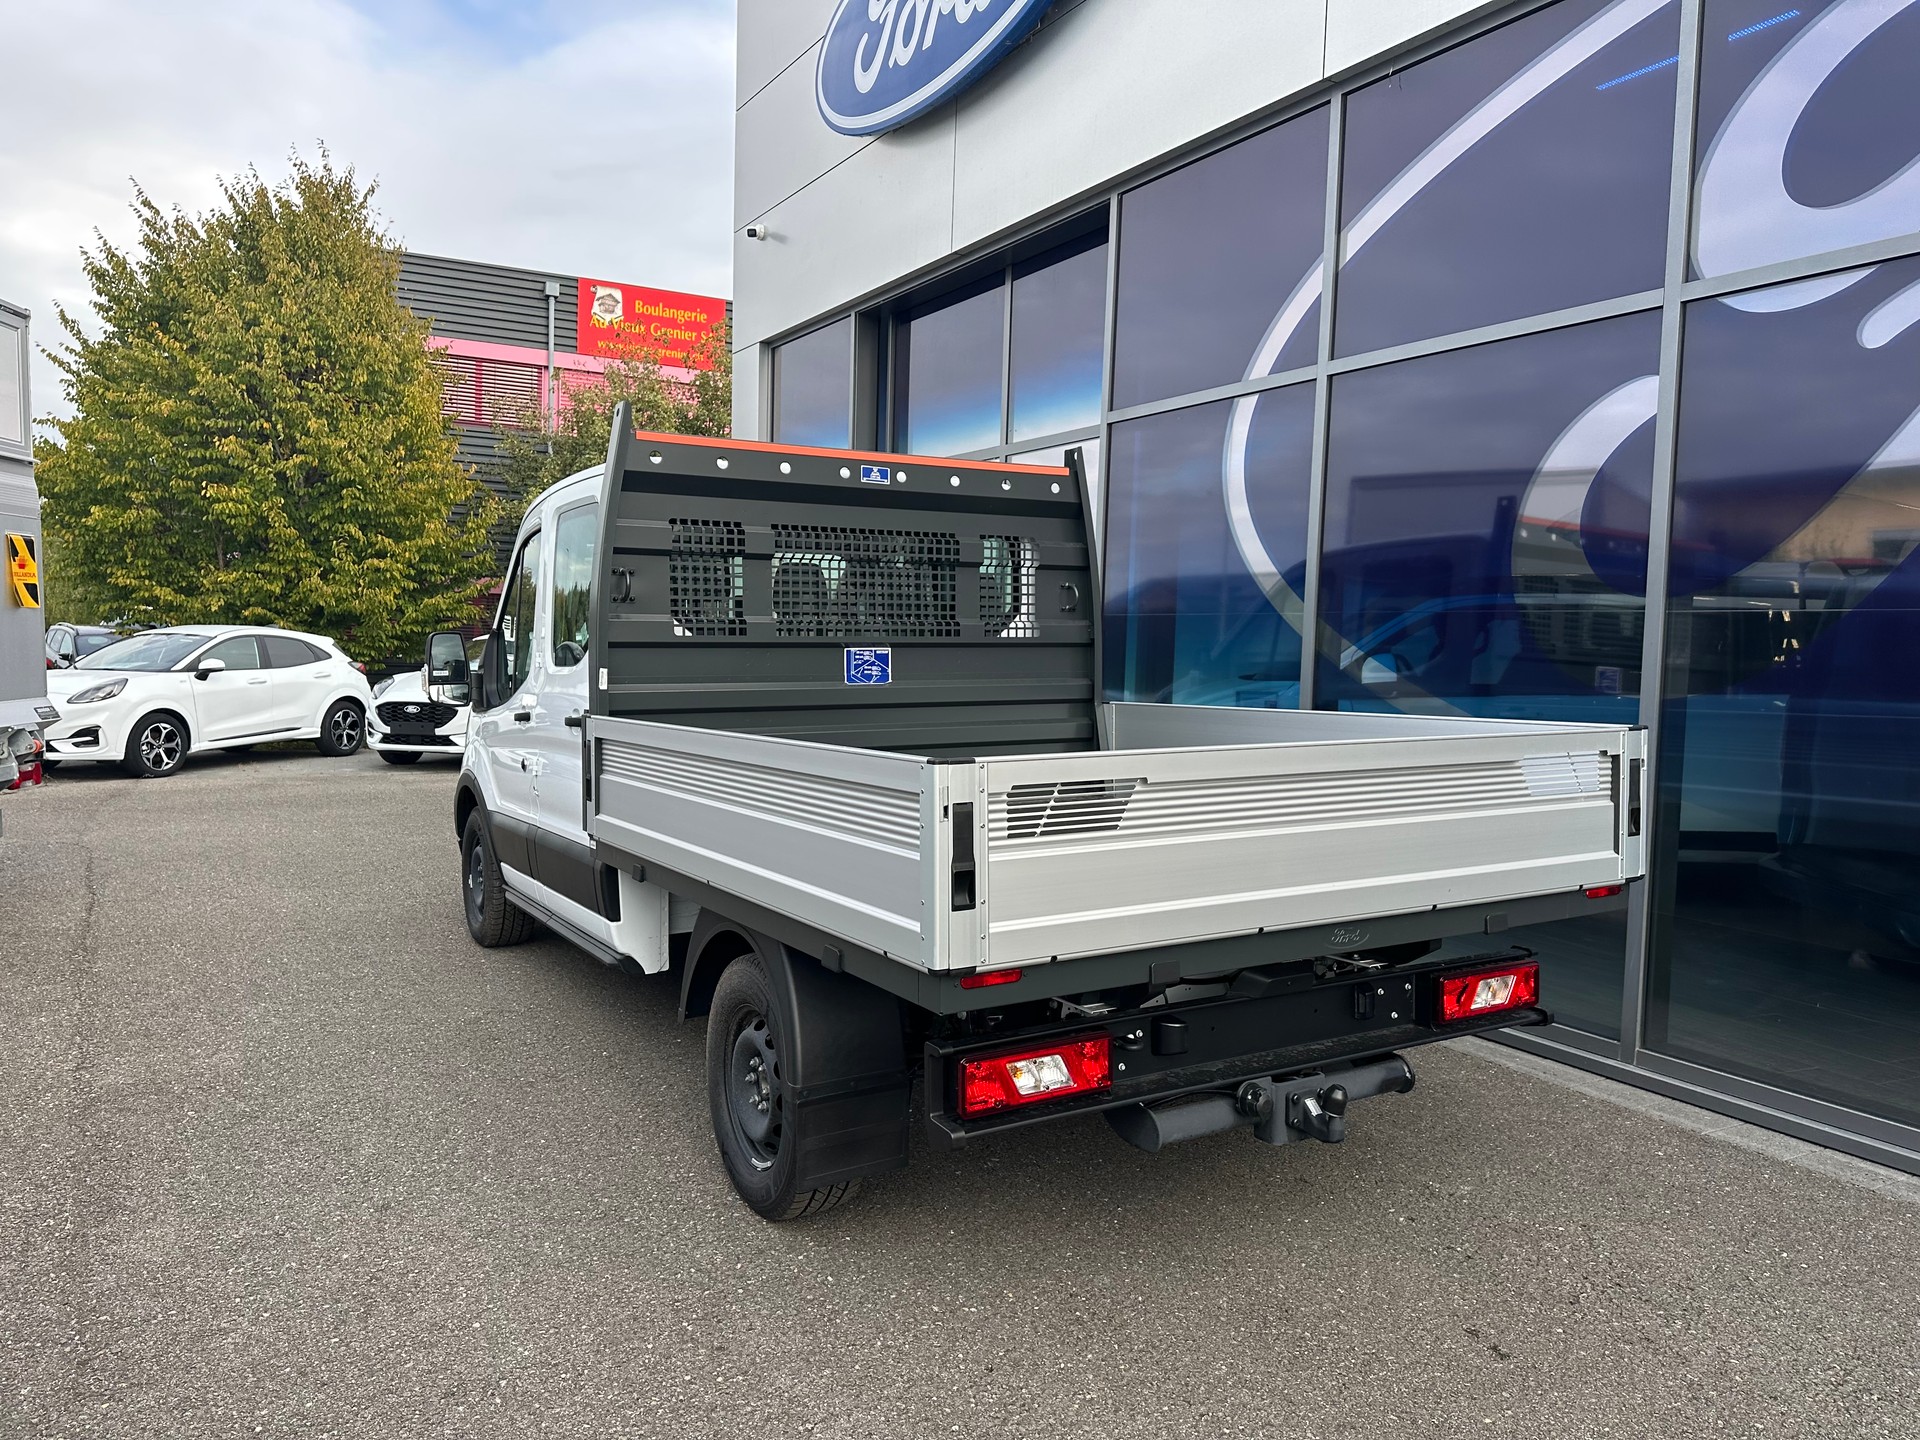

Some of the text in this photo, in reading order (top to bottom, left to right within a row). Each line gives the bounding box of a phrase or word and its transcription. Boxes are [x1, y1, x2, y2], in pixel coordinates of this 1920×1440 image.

[635, 299, 708, 324] Boulangerie
[589, 314, 607, 329] Au
[650, 322, 697, 342] Grenier
